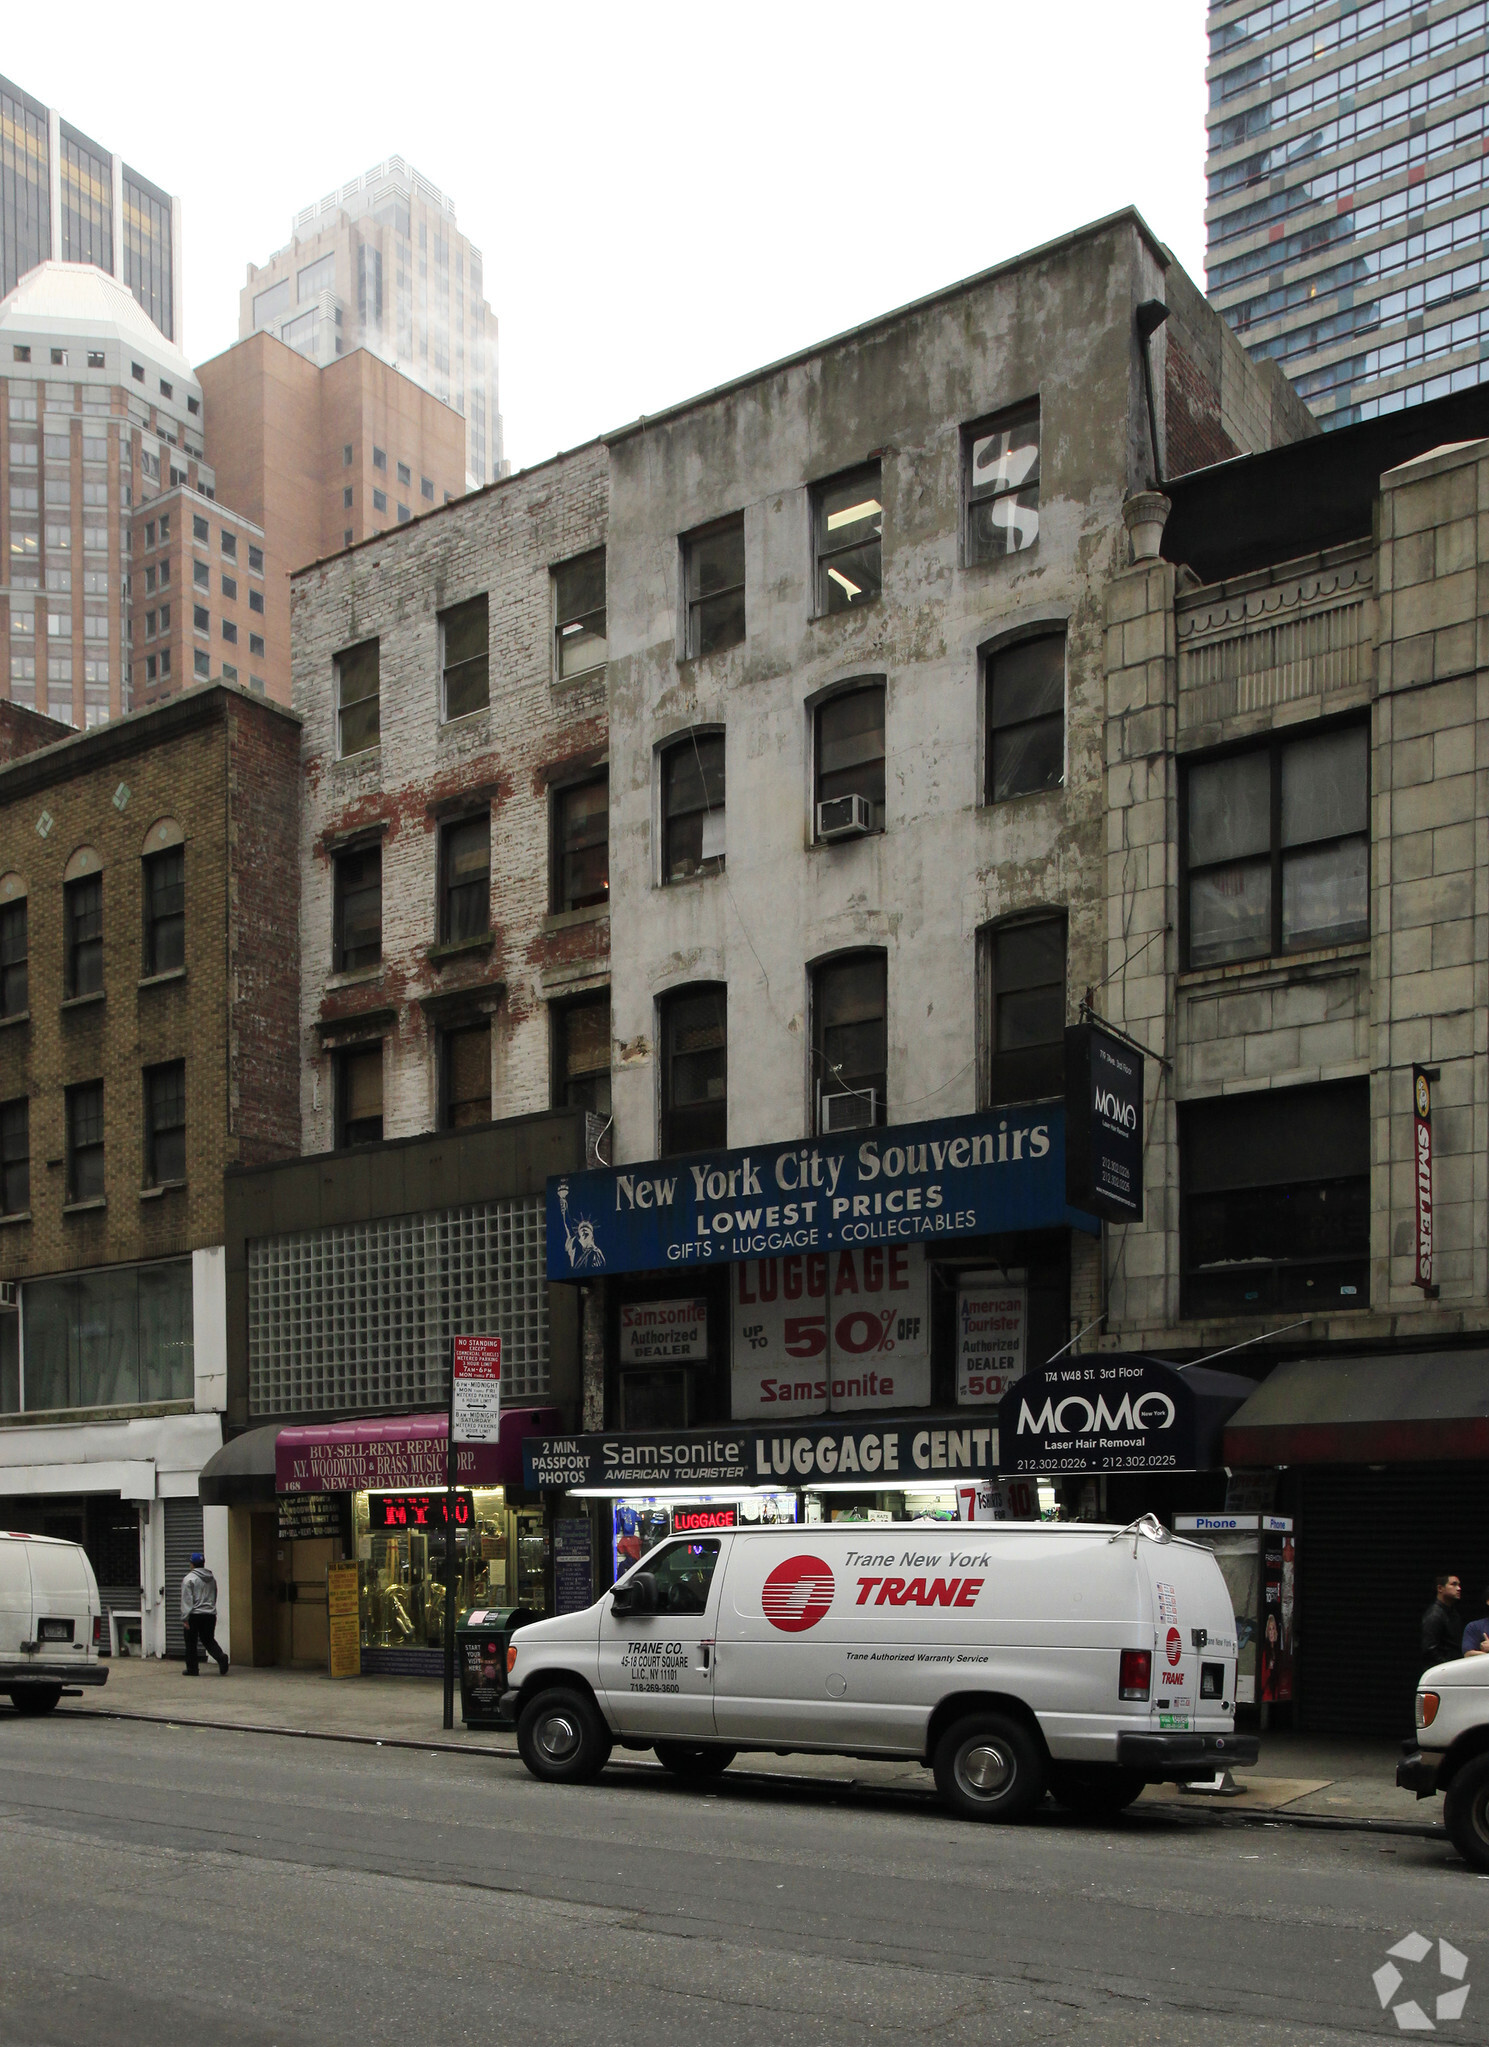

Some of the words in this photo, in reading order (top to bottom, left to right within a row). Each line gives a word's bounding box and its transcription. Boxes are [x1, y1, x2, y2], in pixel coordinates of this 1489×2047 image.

[1095, 1085, 1137, 1130] MOMO
[615, 1174, 678, 1212] New
[689, 1157, 763, 1202] York
[775, 1149, 845, 1198] City
[858, 1120, 1050, 1181] Souvenirs
[697, 1201, 818, 1235] LOWEST
[832, 1185, 943, 1219] PRICES
[667, 1240, 712, 1261] GIFTS
[732, 1228, 819, 1254] LUGGAGE
[841, 1209, 976, 1241] COLLECTABLES
[739, 1243, 909, 1305] LUGGAGE
[622, 1302, 706, 1327] Samsonite
[961, 1299, 1021, 1316] American
[743, 1325, 763, 1338] UP
[962, 1316, 1020, 1335] Tourister
[631, 1327, 698, 1345] Authorized
[784, 1309, 897, 1358] 50%
[897, 1317, 920, 1340] OFF
[468, 1339, 498, 1347] STANDING
[634, 1344, 691, 1357] DEALER
[749, 1337, 768, 1349] TO
[962, 1338, 1019, 1353] Authorized
[967, 1356, 1014, 1371] DEALER
[1045, 1371, 1058, 1382] 174
[1061, 1370, 1082, 1381] W48
[1084, 1369, 1095, 1380] ST.
[1100, 1367, 1116, 1379] 3rd
[1119, 1367, 1144, 1378] Floor
[760, 1371, 894, 1402] Samsonite
[968, 1375, 1008, 1396] 50%
[1016, 1391, 1176, 1435] MOMO
[542, 1442, 549, 1454] 2
[553, 1441, 579, 1454] MIN.
[1045, 1440, 1073, 1450] Laser
[1075, 1438, 1097, 1449] Hair
[1099, 1437, 1145, 1448] Removal
[756, 1433, 899, 1475] LUGGAGE
[293, 1460, 309, 1478] N.Y.
[311, 1457, 366, 1478] WOODWIND
[368, 1463, 375, 1471] &
[377, 1455, 408, 1475] BRASS
[411, 1453, 442, 1473] MUSIC
[531, 1456, 591, 1470] PASSPORT
[1017, 1458, 1087, 1470] 212.302.0226
[1102, 1455, 1176, 1468] 212.302.0225
[538, 1471, 586, 1484] PHOTOS
[604, 1468, 670, 1480] AMERICAN
[674, 1467, 745, 1479] TOURISTER
[285, 1481, 300, 1491] 168
[322, 1473, 443, 1490] NEW-USED-VINTAGE
[959, 1488, 976, 1521] 7
[674, 1511, 734, 1529] LUGGAGE
[1196, 1518, 1237, 1529] Phone
[1269, 1518, 1286, 1530] Phone
[845, 1552, 895, 1567] Trane
[899, 1552, 942, 1567] New
[948, 1552, 992, 1567] York
[855, 1577, 986, 1607] TRANE
[628, 1642, 663, 1654] TRANE
[665, 1642, 683, 1654] CO.
[621, 1656, 638, 1667] 45-18
[638, 1656, 660, 1667] COURT
[661, 1656, 688, 1668] SQUARE
[846, 1652, 869, 1661] Trane
[870, 1653, 915, 1662] Authorized
[917, 1653, 955, 1663] Warranty
[957, 1654, 989, 1663] Service
[650, 1669, 659, 1680] NY
[660, 1669, 677, 1680] 11101
[1161, 1671, 1184, 1686] TRANE
[630, 1683, 680, 1693] 718-269-3600
